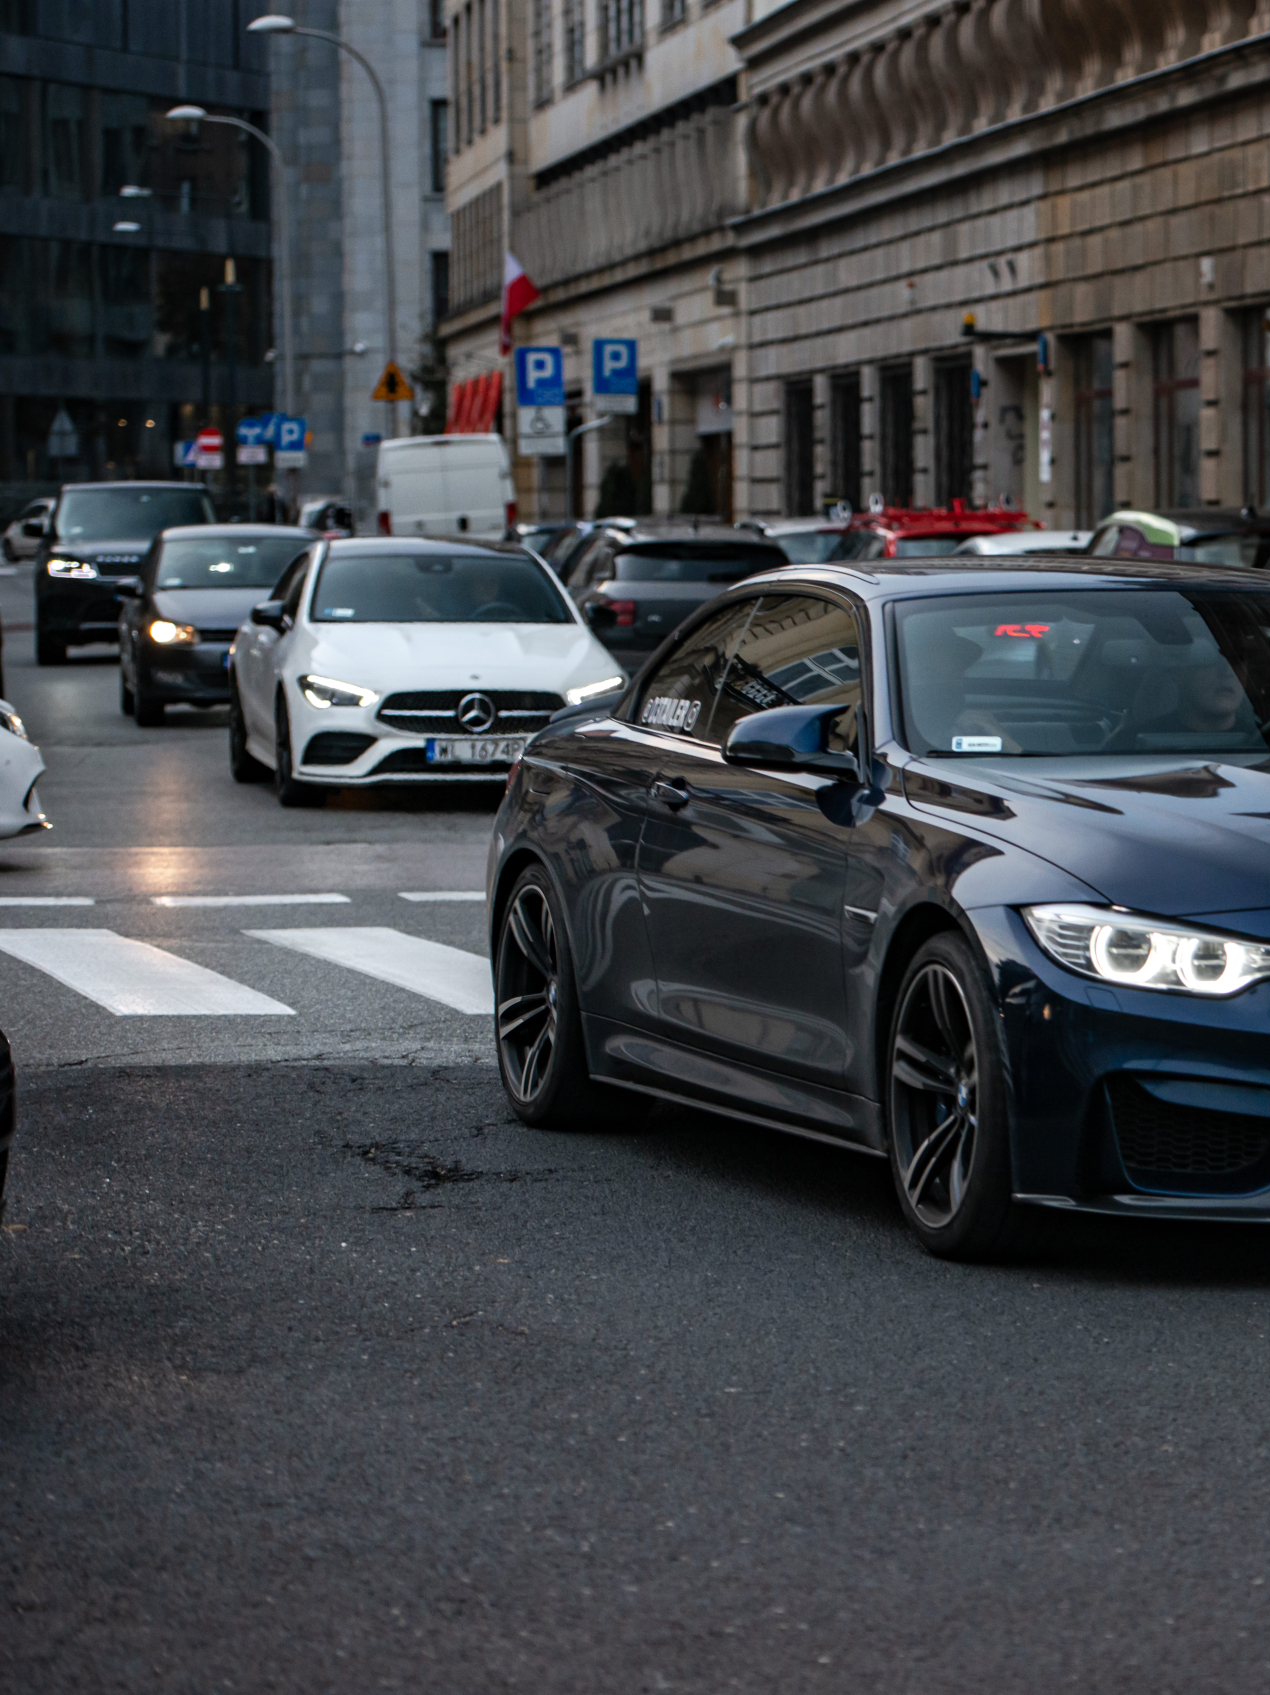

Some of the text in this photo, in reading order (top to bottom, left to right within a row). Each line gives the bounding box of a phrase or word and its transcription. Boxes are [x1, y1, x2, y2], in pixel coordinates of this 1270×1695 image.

[526, 351, 554, 389] P
[603, 343, 628, 377] P
[281, 421, 300, 448] P
[439, 740, 460, 758] WL
